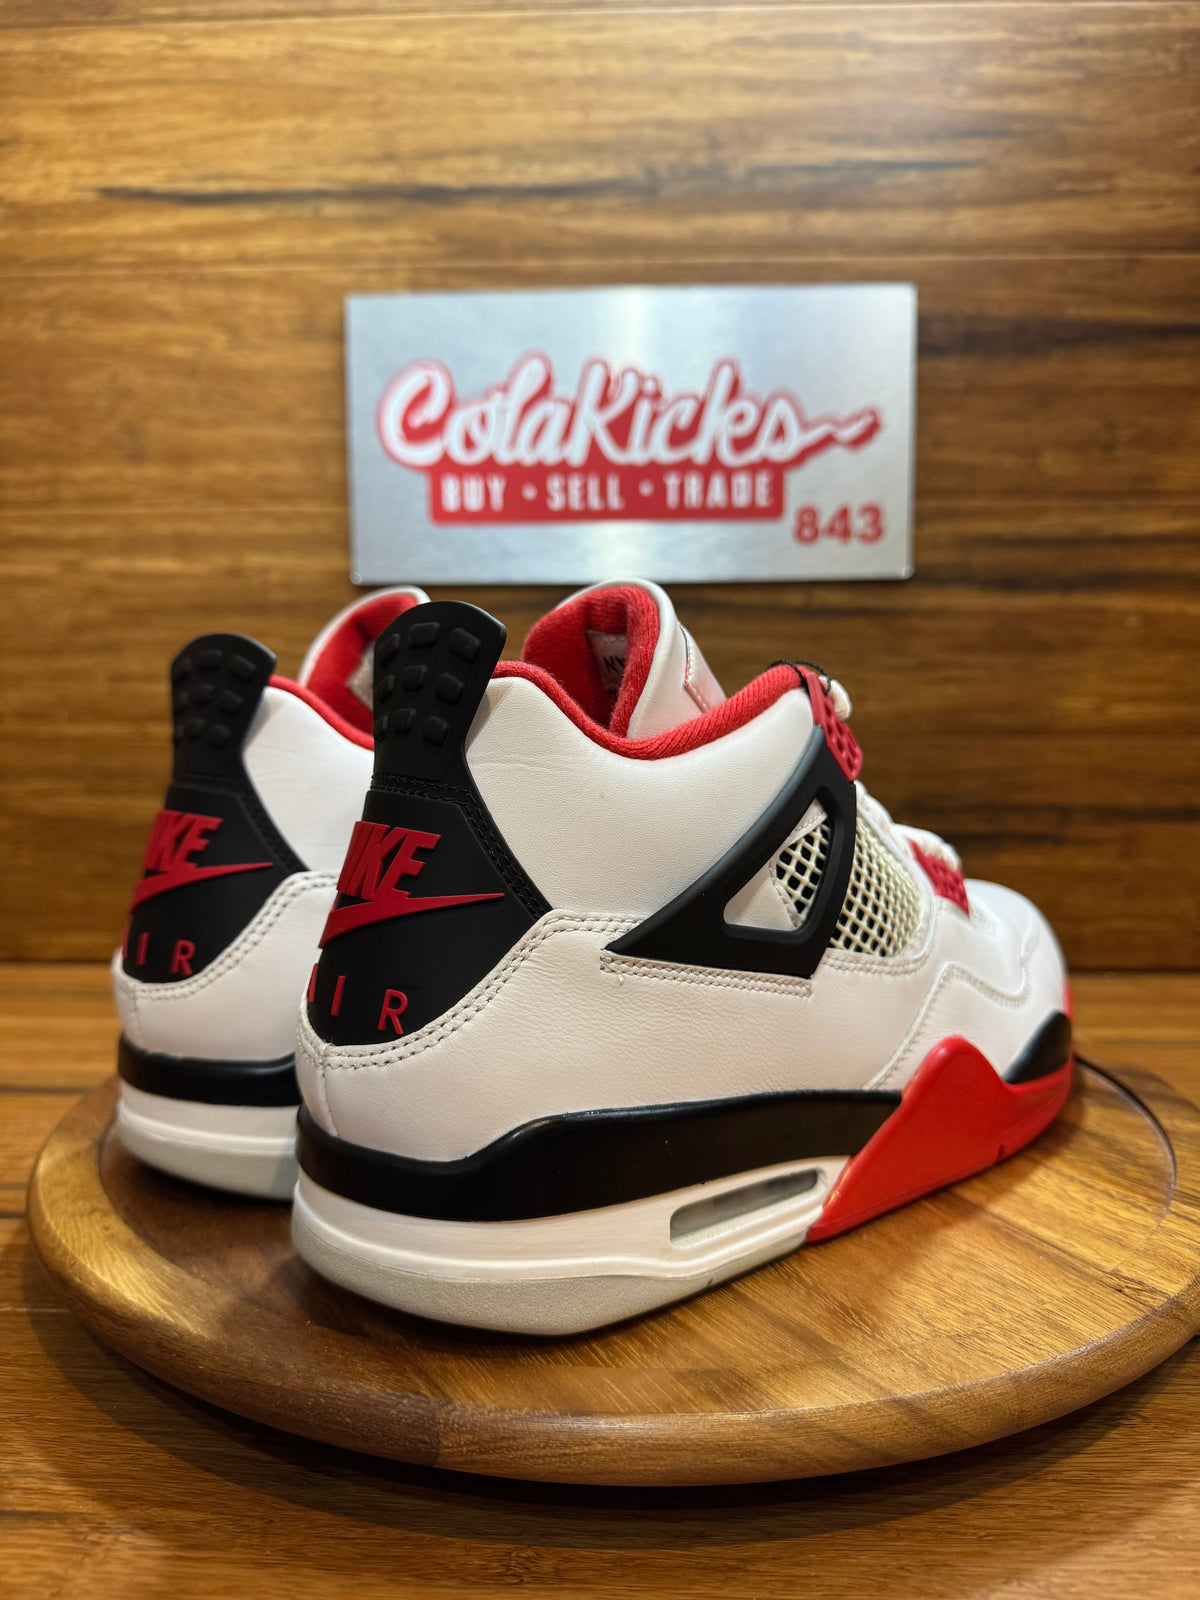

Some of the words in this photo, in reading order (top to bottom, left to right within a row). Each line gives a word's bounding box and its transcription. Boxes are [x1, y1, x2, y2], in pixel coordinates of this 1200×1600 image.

[379, 352, 881, 469] ColaKicks
[441, 472, 506, 511] BUY
[546, 472, 625, 511] SELL
[663, 470, 773, 509] TRADE
[794, 504, 885, 545] 843
[143, 809, 224, 873] IKE
